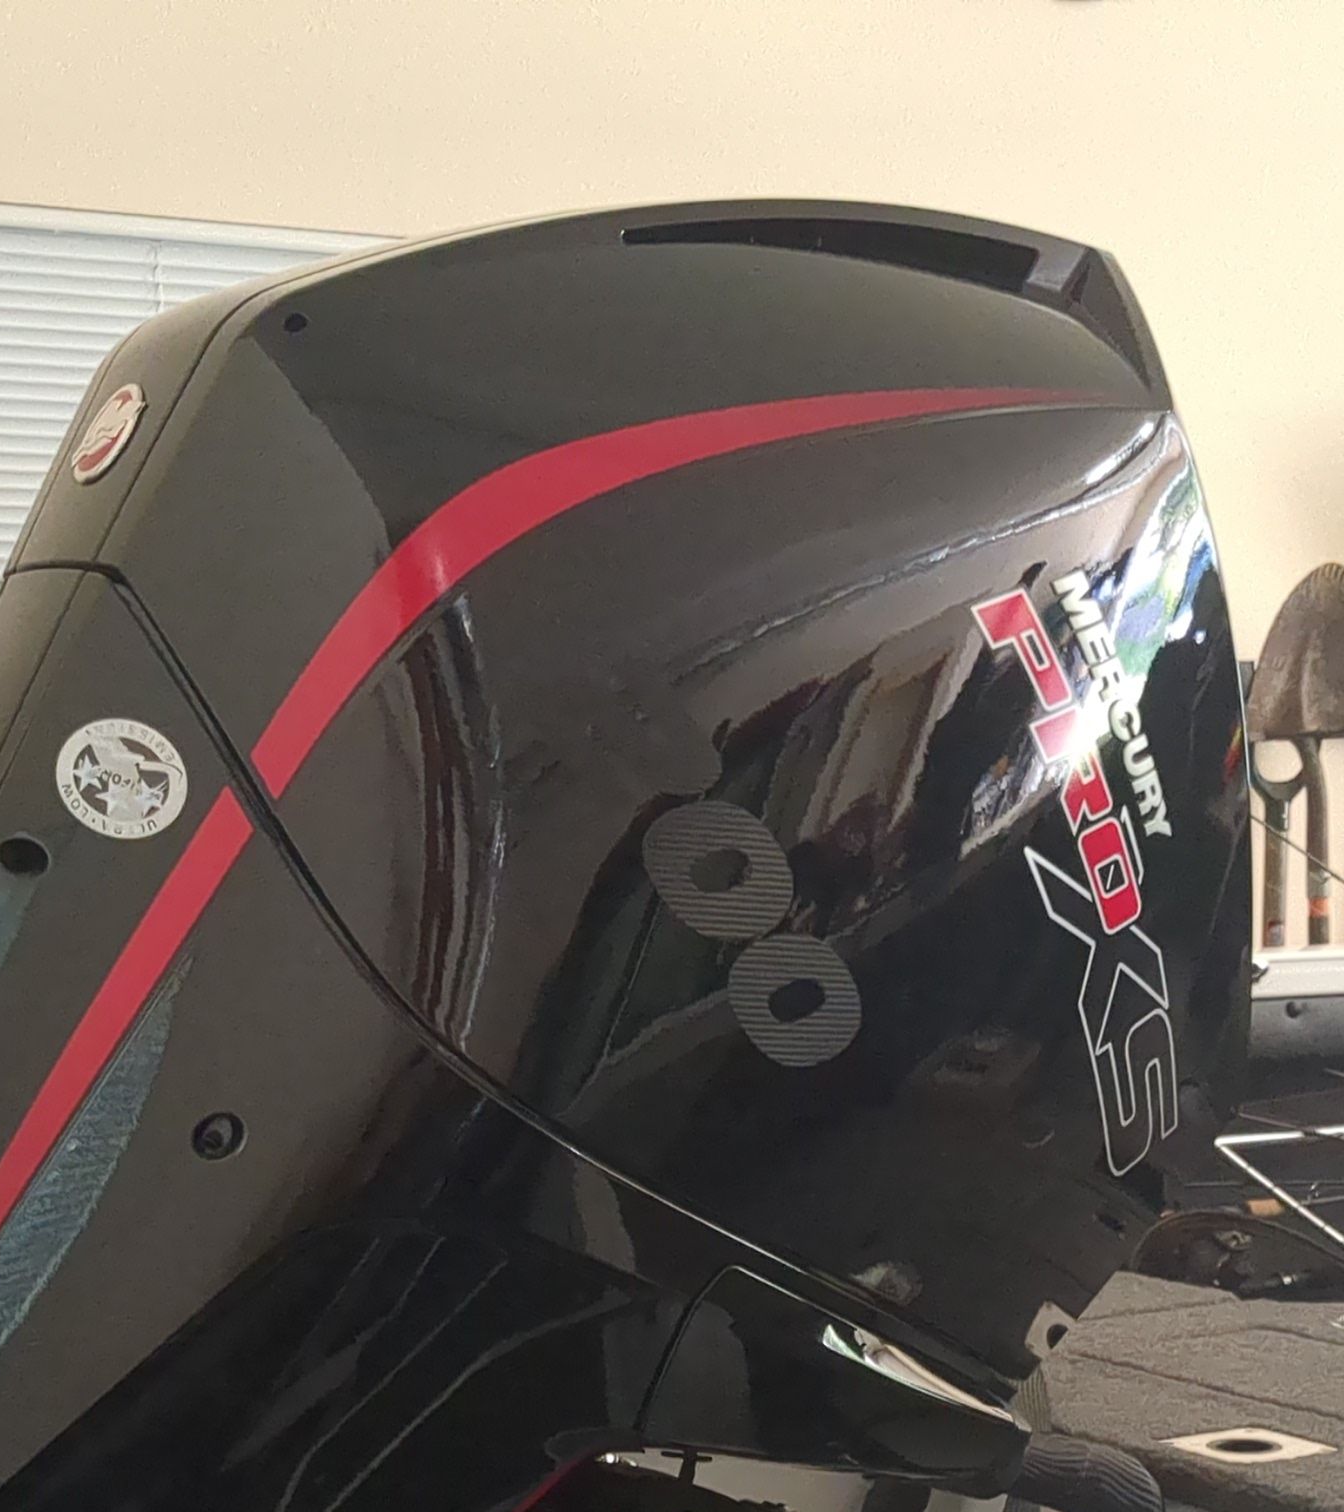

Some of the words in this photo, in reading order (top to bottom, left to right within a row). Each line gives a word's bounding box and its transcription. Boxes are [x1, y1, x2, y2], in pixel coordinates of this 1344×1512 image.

[971, 588, 1142, 935] PRO
[1050, 570, 1172, 837] MERCURY
[1024, 804, 1179, 1177] XS
